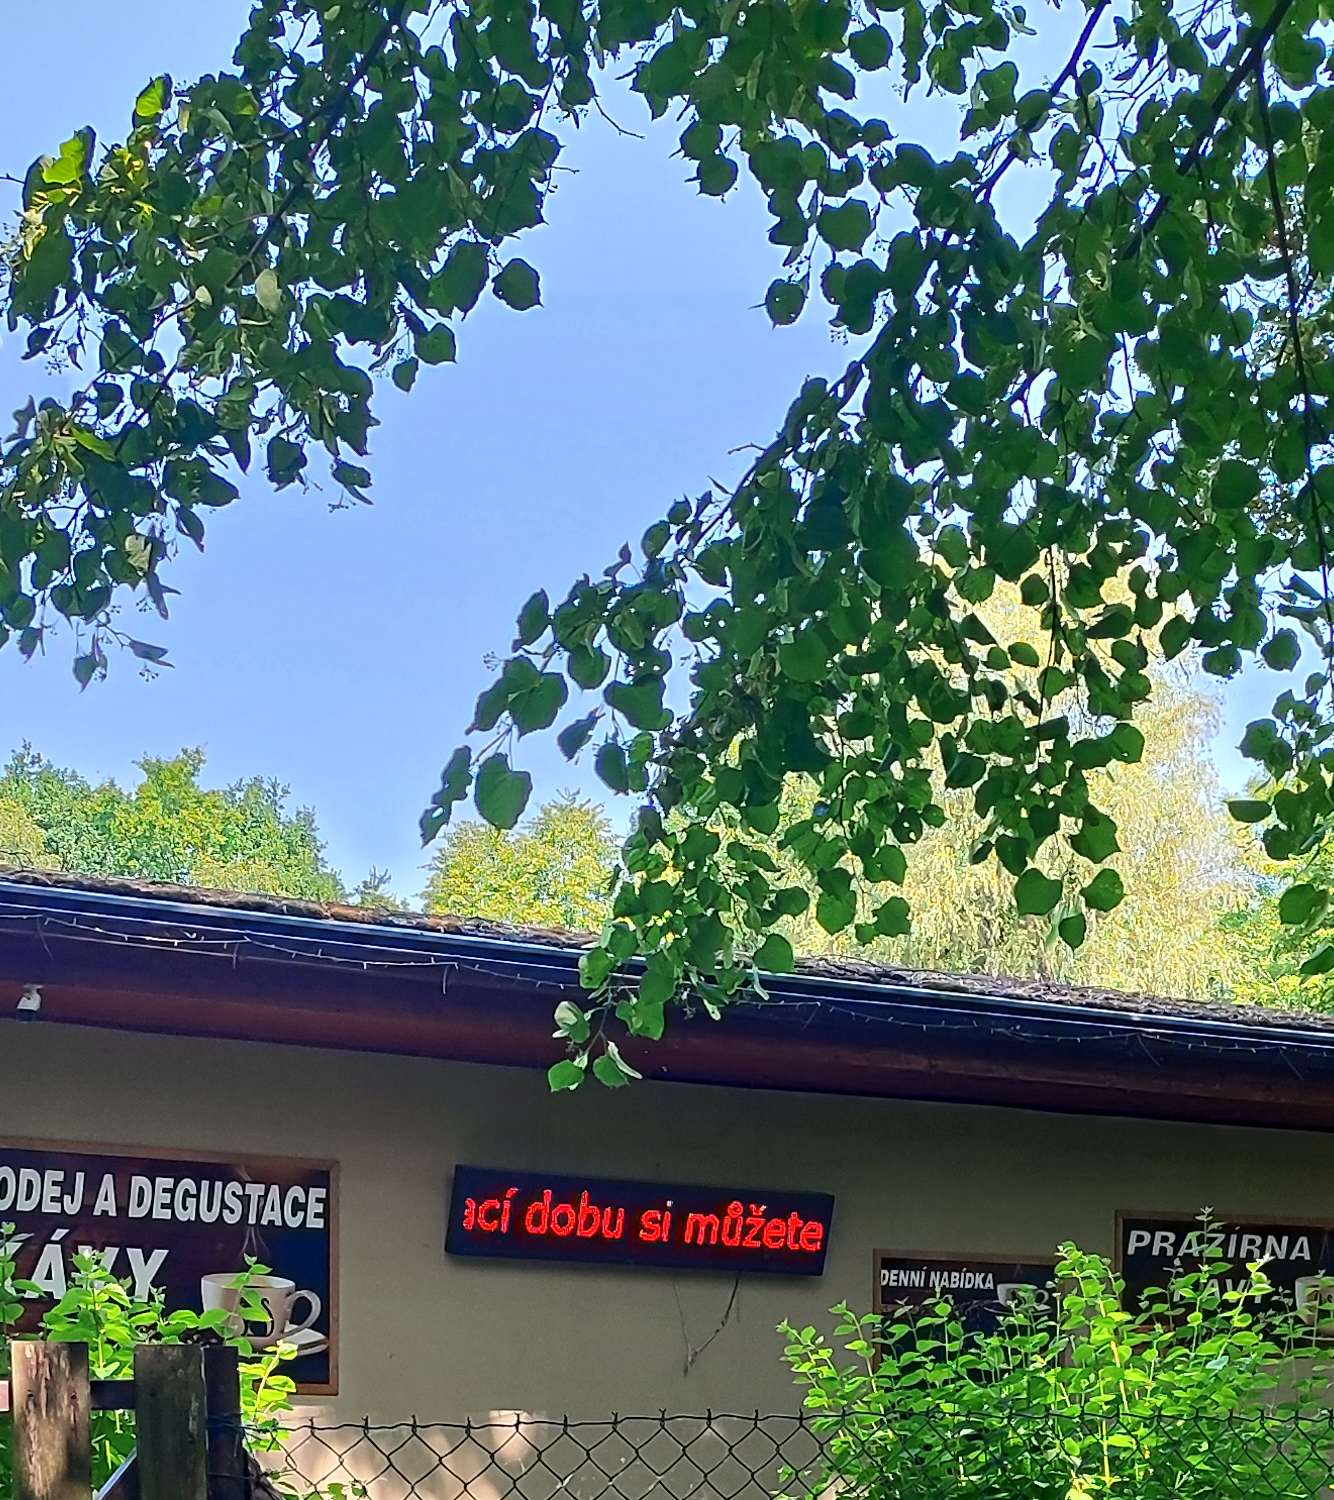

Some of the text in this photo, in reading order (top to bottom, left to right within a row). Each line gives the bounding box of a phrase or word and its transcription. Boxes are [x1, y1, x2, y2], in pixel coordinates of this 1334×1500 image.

[92, 1173, 117, 1218] A
[127, 1175, 327, 1230] DEGUSTACE
[524, 1189, 625, 1239] dobu
[638, 1200, 673, 1243] si
[684, 1201, 823, 1252] můžete
[880, 1266, 995, 1290] DENNÍ NABÍDKA
